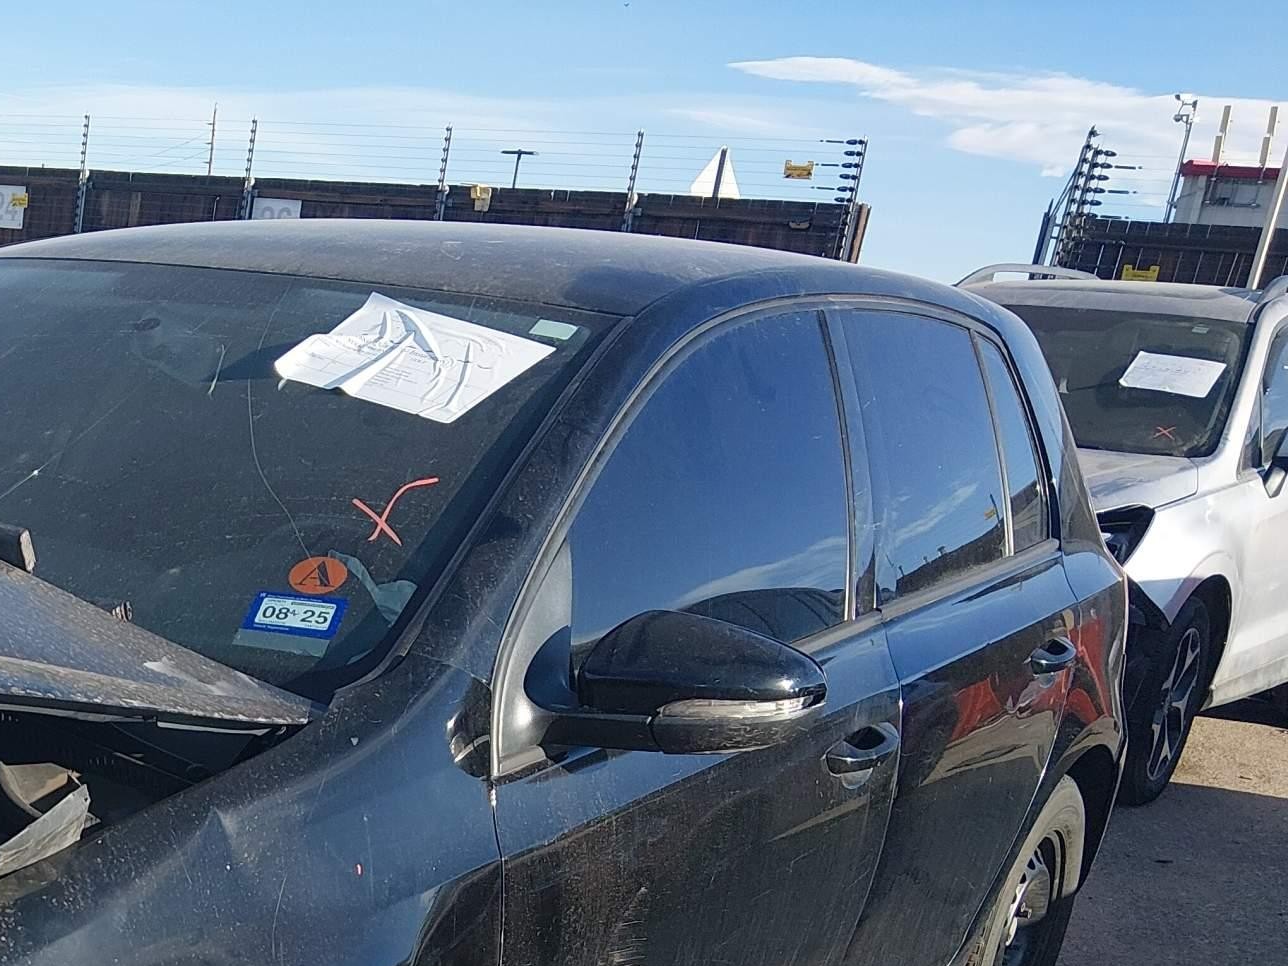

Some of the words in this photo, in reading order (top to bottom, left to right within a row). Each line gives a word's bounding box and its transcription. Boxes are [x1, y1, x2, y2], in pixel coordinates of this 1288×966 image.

[297, 561, 337, 588] A
[262, 605, 290, 621] 08
[299, 609, 329, 625] 25
